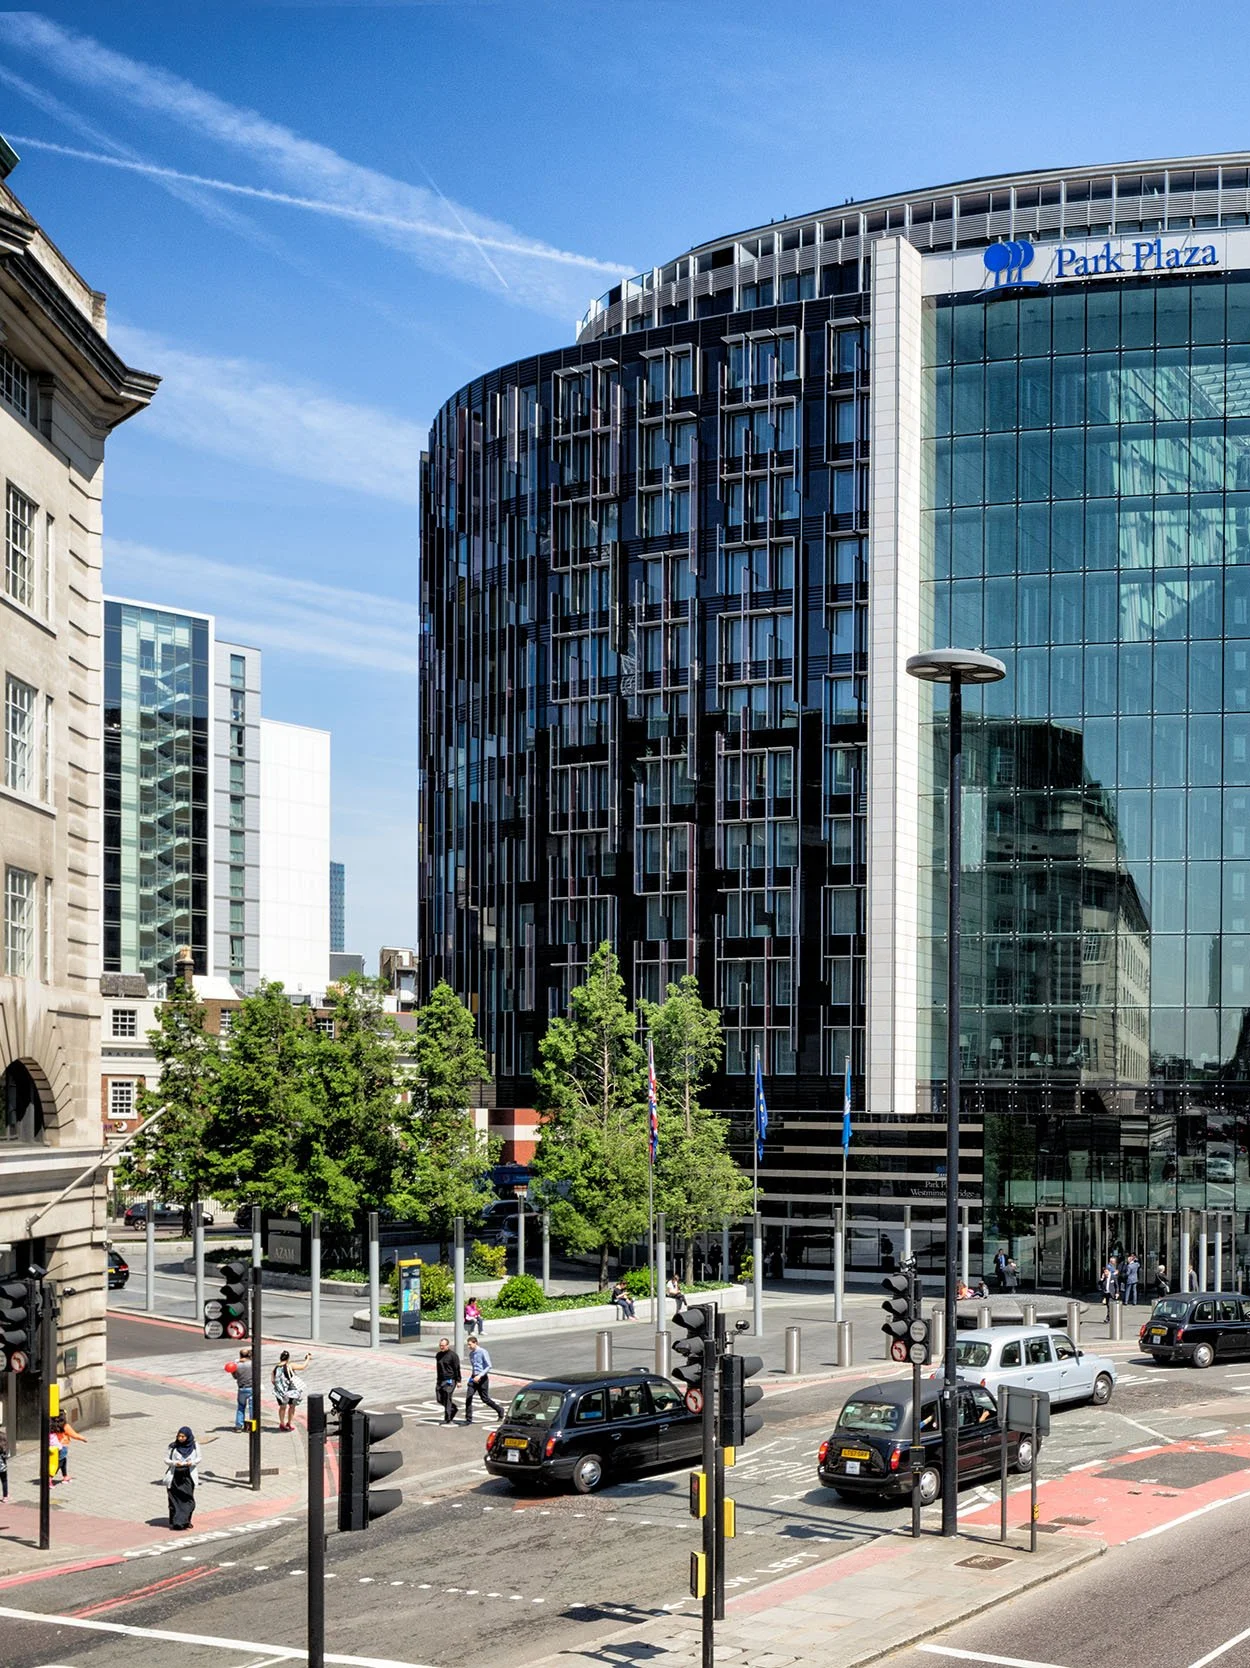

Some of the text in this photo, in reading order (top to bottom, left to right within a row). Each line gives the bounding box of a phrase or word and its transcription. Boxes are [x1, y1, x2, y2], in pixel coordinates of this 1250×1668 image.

[1056, 238, 1219, 278] Park Plaza
[275, 1247, 295, 1261] AZAM
[320, 1246, 355, 1260] ZAM
[754, 1552, 819, 1574] LEFT
